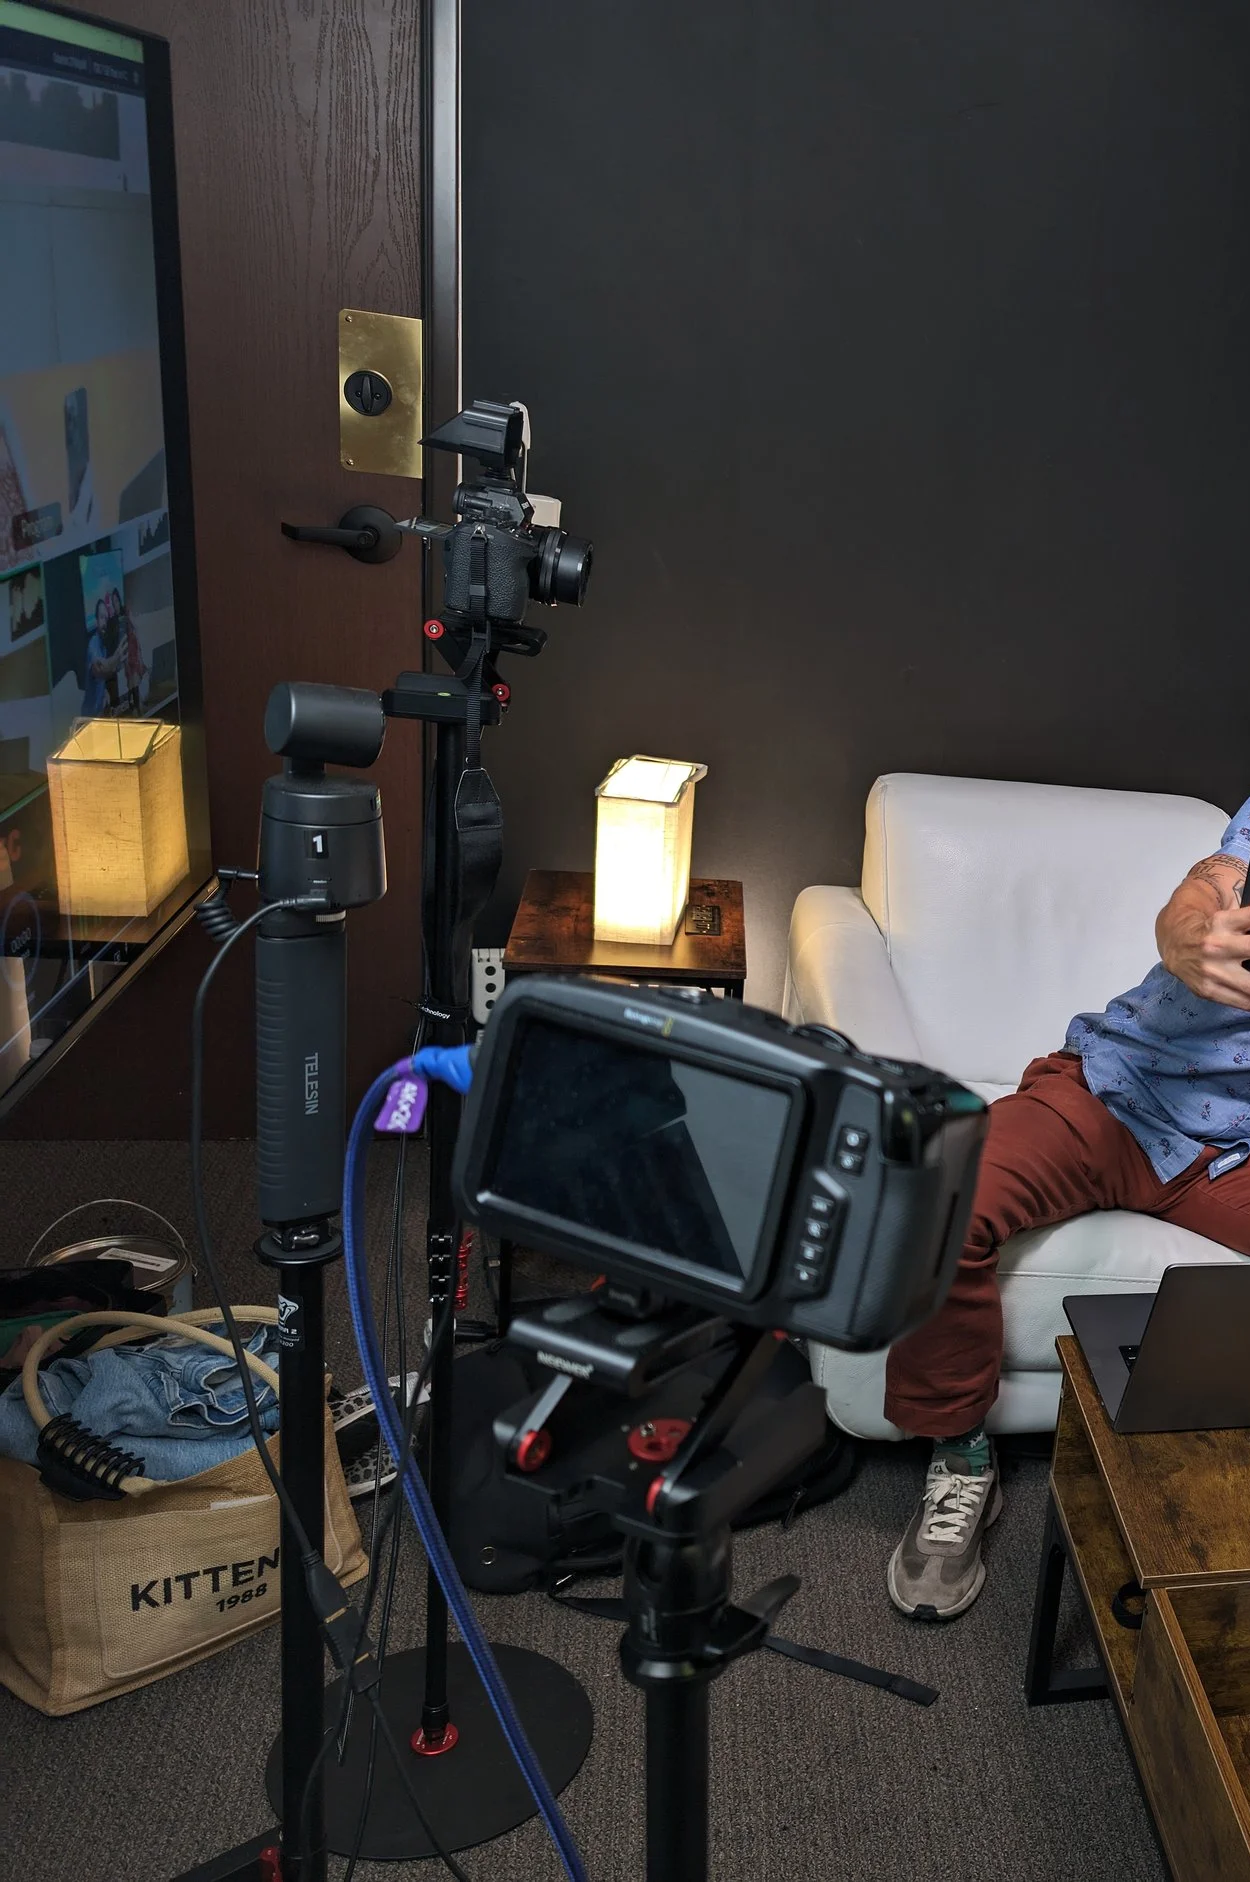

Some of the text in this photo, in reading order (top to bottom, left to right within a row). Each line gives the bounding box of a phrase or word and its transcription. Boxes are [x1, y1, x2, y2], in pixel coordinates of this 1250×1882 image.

[312, 834, 323, 853] 1
[304, 1052, 319, 1115] TELESIN
[131, 1546, 280, 1612] KITTEN
[215, 1582, 268, 1613] 1988
